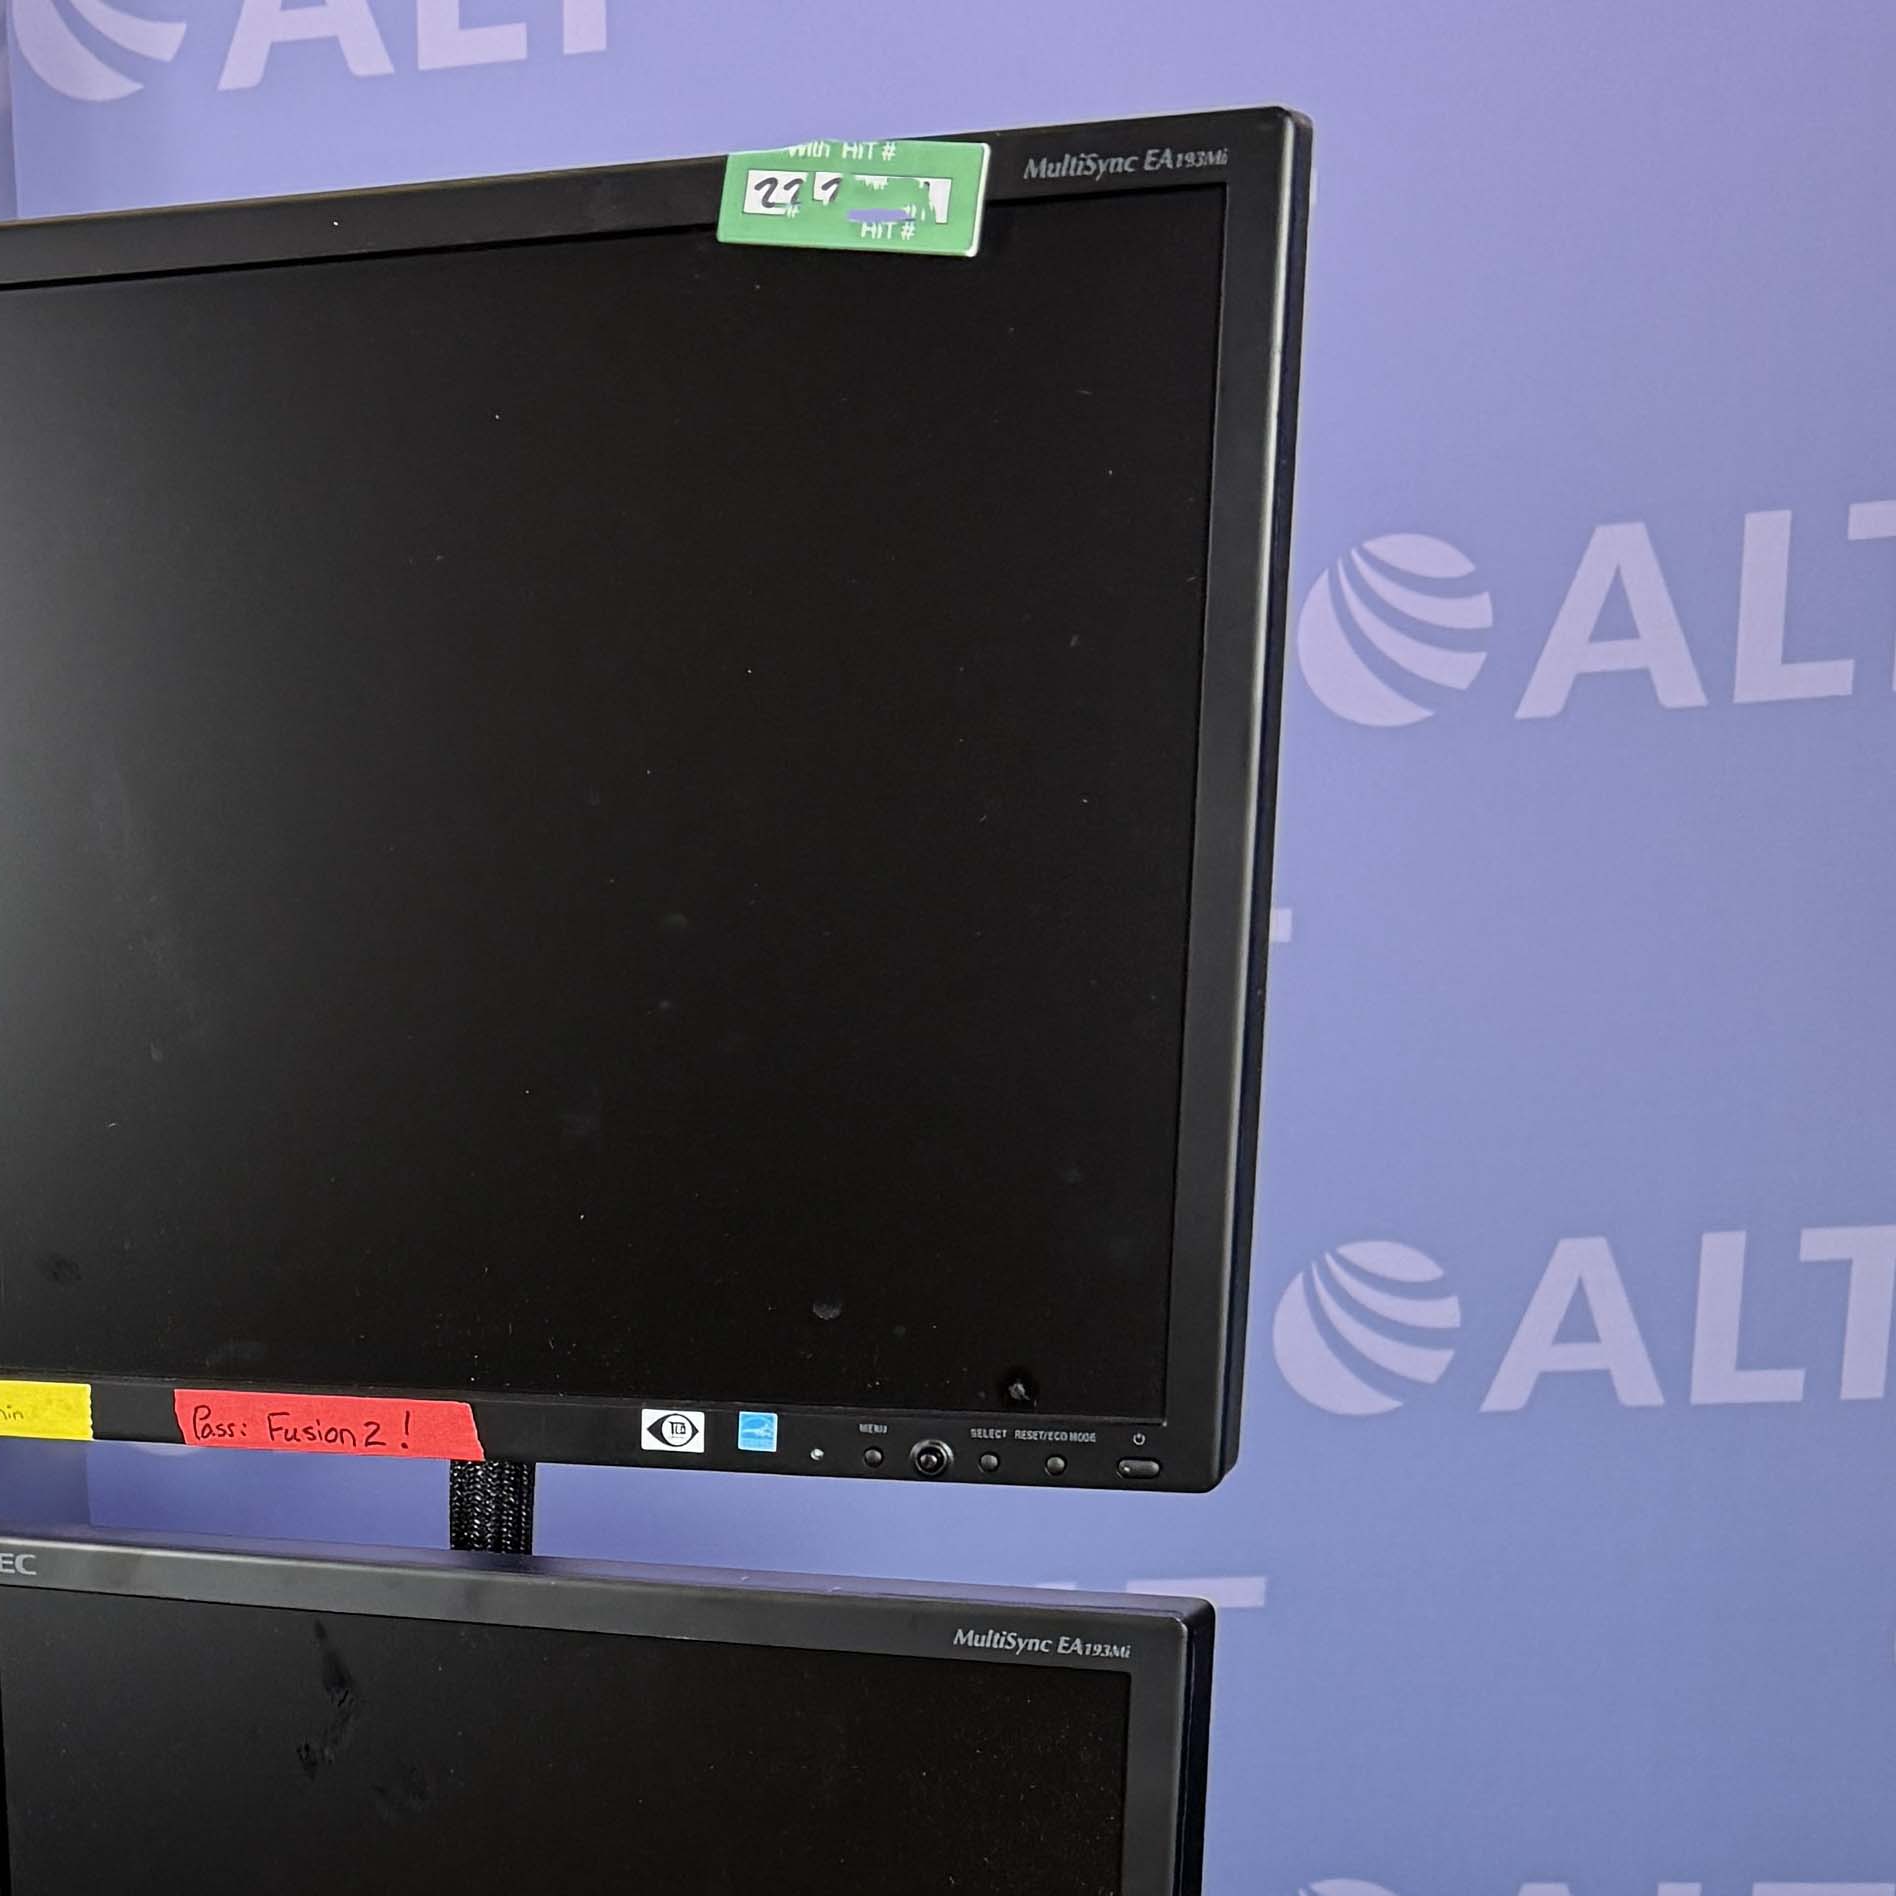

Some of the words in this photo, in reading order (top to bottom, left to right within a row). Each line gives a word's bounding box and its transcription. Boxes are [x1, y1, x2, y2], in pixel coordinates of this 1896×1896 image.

[1023, 153, 1139, 182] MultiSync
[1515, 500, 1896, 719] AL
[1480, 1225, 1896, 1412] ALT
[970, 1428, 1008, 1439] SELECT
[953, 1628, 1053, 1656] MultiSync
